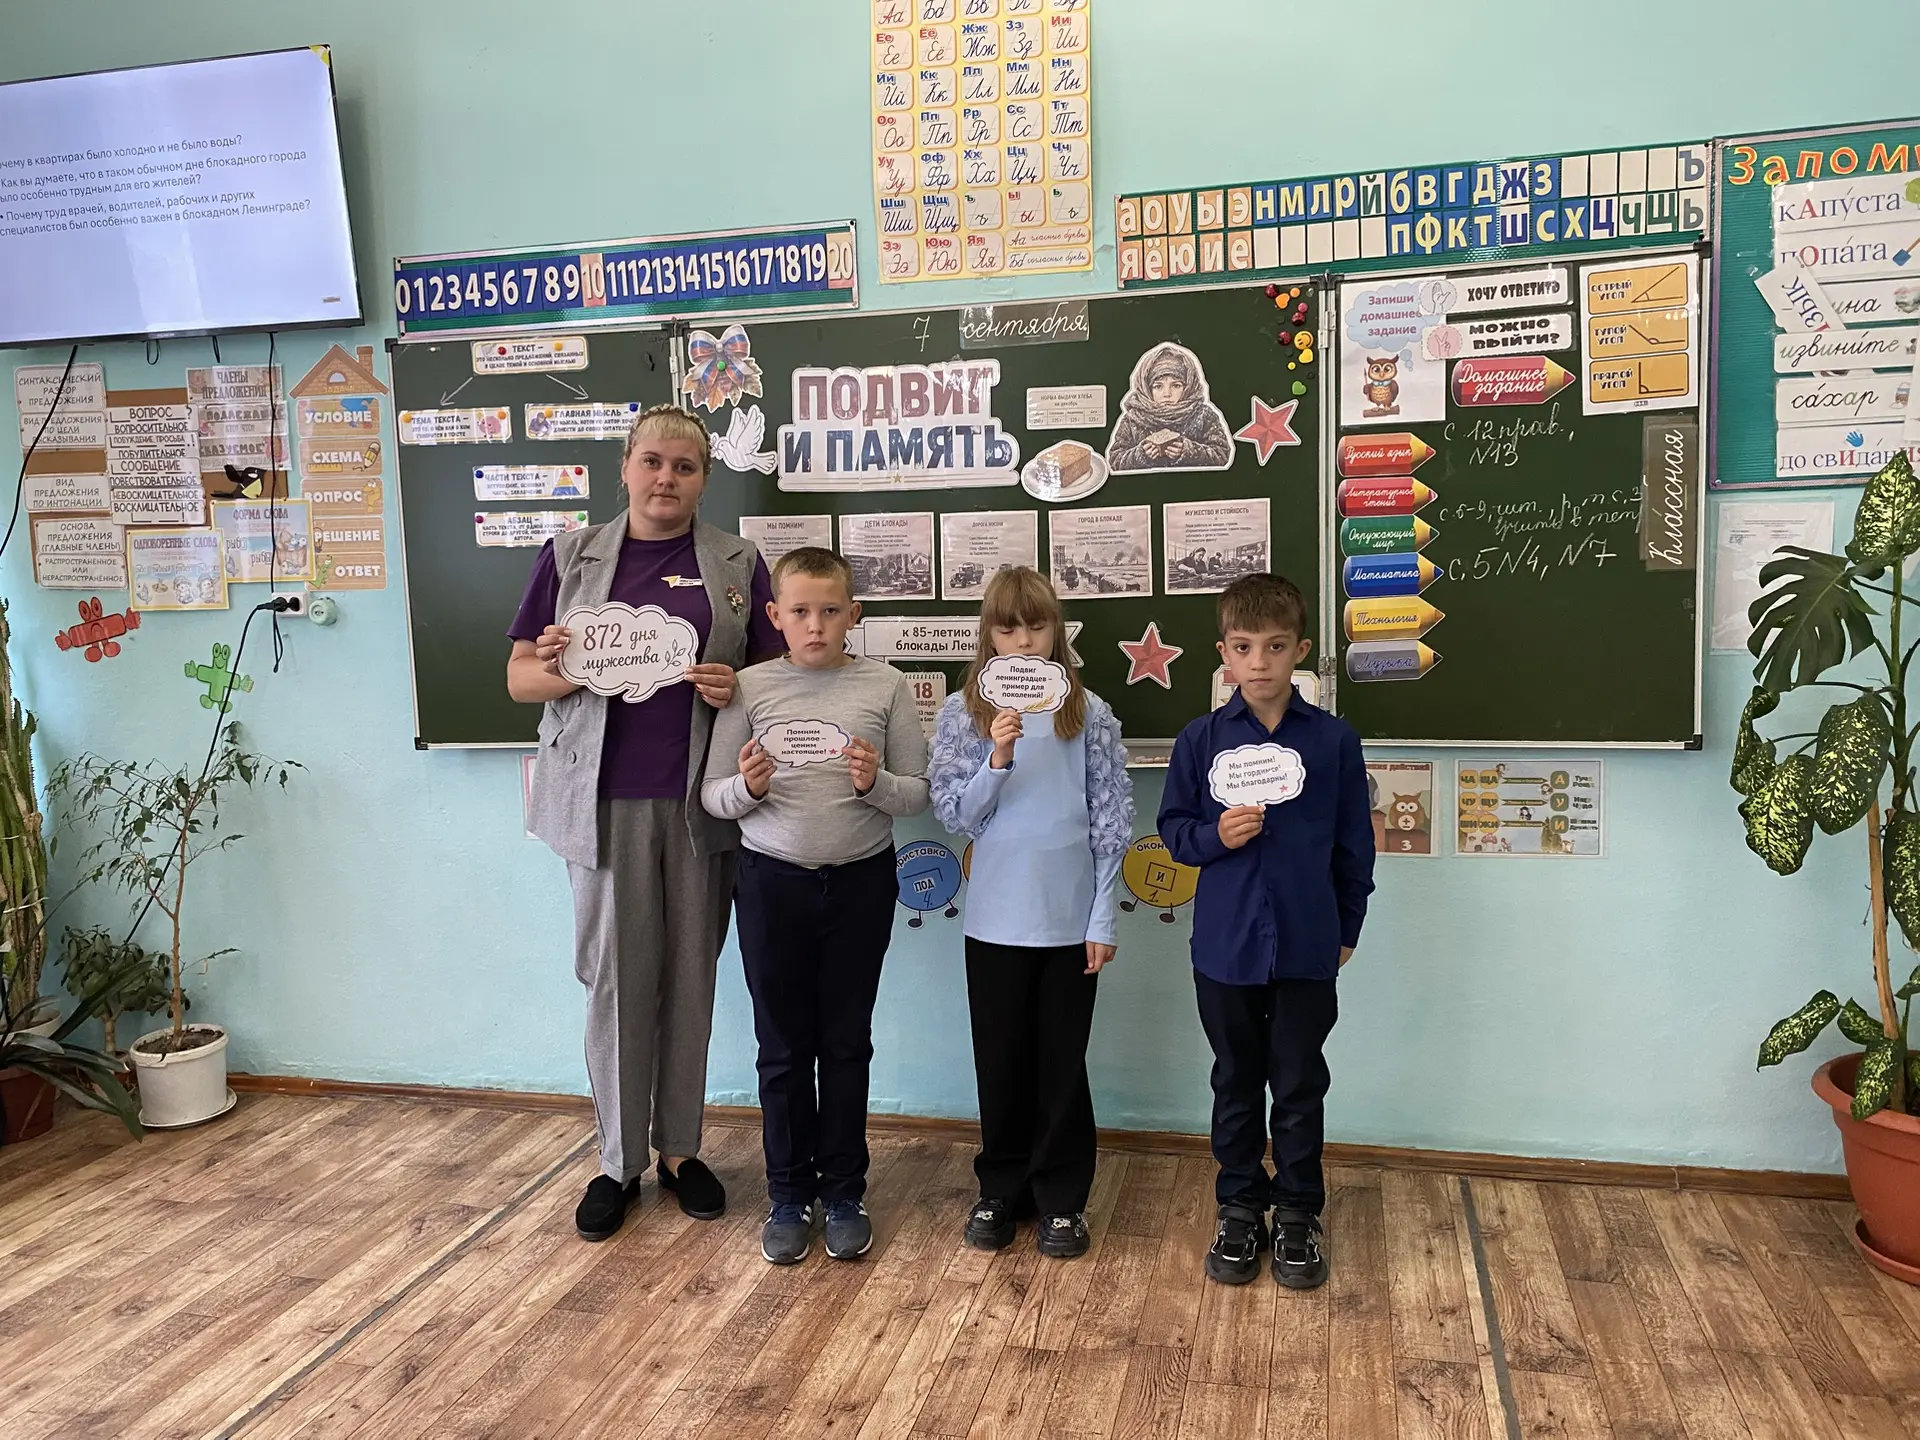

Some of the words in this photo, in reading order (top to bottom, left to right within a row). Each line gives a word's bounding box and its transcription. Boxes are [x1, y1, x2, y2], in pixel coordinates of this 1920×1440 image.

[35, 154, 85, 166] квартирах
[87, 149, 112, 160] было
[114, 145, 156, 158] холодно
[167, 143, 180, 152] не
[182, 139, 208, 150] было
[210, 134, 242, 148] воды?
[1, 178, 18, 188] Как
[35, 173, 78, 186] думаете,
[79, 171, 96, 180] что
[106, 167, 135, 178] таком
[137, 162, 183, 174] обычном
[185, 160, 204, 172] дне
[206, 154, 268, 168] блокадного
[270, 151, 306, 164] города
[1728, 142, 1920, 186] Запом
[21, 188, 68, 201] особенно
[70, 185, 112, 198] трудным
[114, 182, 132, 193] для
[134, 180, 150, 191] его
[152, 174, 202, 188] жителей?
[6, 209, 43, 222] Почему
[44, 207, 67, 220] труд
[69, 203, 107, 217] врачей,
[109, 199, 165, 213] водителей,
[167, 195, 210, 209] рабочих
[220, 190, 256, 204] других
[0, 221, 67, 237] специалистов
[70, 219, 88, 230] был
[90, 216, 138, 229] особенно
[141, 212, 172, 224] важен
[182, 205, 240, 220] блокадном
[242, 199, 311, 215] Ленинграде?
[1591, 280, 1632, 292] ОСТРЫЙ
[1468, 286, 1498, 302] ХОЧУ
[1599, 291, 1625, 300] УГОЛ
[1368, 295, 1414, 306] Запиши
[1368, 325, 1417, 337] задание
[1469, 318, 1551, 335] МОЖНО
[1594, 324, 1627, 336] ТУПОЙ
[913, 316, 931, 352] 7
[1472, 332, 1561, 350] ВЫЙТИ?
[1598, 336, 1624, 345] УГОЛ
[512, 344, 536, 353] ТЕКСТ
[216, 371, 248, 384] ЧЛЕНЫ
[1458, 362, 1548, 384] Домашнее
[1593, 368, 1632, 381] ПРЯМОЙ
[1472, 379, 1545, 402] задание
[1600, 380, 1626, 390] УГОЛ
[798, 367, 993, 426] ПОДВИГ
[130, 406, 173, 419] ВОПРОС
[304, 410, 372, 424] УСЛОВИЕ
[555, 409, 592, 418] ГЛАВНАЯ
[593, 408, 621, 417] МЫСЛЬ
[24, 417, 40, 426] ВИД
[412, 416, 432, 425] ТЕМА
[434, 415, 462, 424] ТЕКСТА
[58, 426, 80, 434] ЦЕЛИ
[114, 422, 188, 434] ВОПРОСИТЕЛЬНОЕ
[114, 436, 154, 444] ПОБУЖДЕНИЕ
[156, 434, 186, 443] ПРОСЬБА
[118, 448, 186, 459] ПОБУДИТЕЛЬНОЕ
[784, 430, 812, 474] И
[826, 425, 1012, 474] ПАМЯТЬ
[1344, 446, 1386, 465] Русский
[1387, 448, 1413, 462] язык
[312, 450, 363, 464] СХЕМА
[1780, 454, 1806, 470] до
[120, 460, 182, 472] СООБЩЕНИЕ
[56, 478, 75, 488] ВИД
[110, 476, 197, 486] ПОВЕСТВОВАТЕЛЬНОЕ
[485, 474, 510, 482] ЧАСТИ
[512, 472, 540, 480] ТЕКСТА
[34, 488, 100, 498] ПРЕДЛОЖЕНИЯ
[112, 490, 198, 500] НЕВОСКЛИЦАТЕЛЬНОЕ
[304, 490, 363, 504] ВОПРОС
[1344, 486, 1414, 500] Литературное
[33, 500, 44, 508] ПО
[46, 498, 103, 509] ИНТОНАЦИИ
[114, 502, 199, 514] ВОСКЛИЦАТЕЛЬНОЕ
[233, 508, 260, 520] ФОРМА
[264, 507, 288, 519] СЛОВА
[1078, 516, 1095, 524] ГОРОД
[1100, 514, 1123, 522] БЛОКАДЕ
[60, 522, 96, 531] ОСНОВА
[507, 516, 532, 525] АБЗАЦ
[766, 522, 778, 530] МЫ
[778, 522, 805, 530] ПОМНИМ!
[864, 520, 880, 528] ДЕТИ
[882, 519, 908, 528] БЛОКАДЫ
[48, 532, 113, 542] ПРЕДЛОЖЕНИЯ
[314, 529, 380, 542] РЕШЕНИЕ
[1348, 528, 1416, 545] Окружающий
[42, 543, 83, 552] (ГЛАВНЫЕ
[86, 542, 120, 551] ЧЛЕНЫ)
[134, 537, 192, 550] ОДНОКОРЕННЫЕ
[194, 536, 218, 548] СЛОВА
[1372, 540, 1396, 552] мир
[335, 565, 380, 578] ОТВЕТ
[1350, 568, 1421, 580] Математика
[1354, 612, 1419, 626] Технология
[583, 622, 622, 651] 872
[630, 628, 658, 650] дня
[912, 626, 971, 638] 85-летию
[896, 640, 948, 652] блокады
[582, 646, 660, 676] мужества
[1356, 652, 1413, 676] Музыка
[1010, 666, 1037, 675] Подвиг
[995, 674, 1047, 684] ленинградцев
[914, 682, 932, 698] 18
[1002, 683, 1030, 692] пример
[1031, 683, 1044, 692] для
[1002, 690, 1044, 700] поколений!
[1229, 762, 1242, 770] Мы
[1244, 756, 1276, 769] помним!
[1228, 772, 1242, 780] Мы
[1244, 764, 1282, 779] гордимся!
[1226, 782, 1240, 790] Мы
[1241, 773, 1288, 788] благодарны!
[1460, 775, 1476, 784] ЧА
[1480, 775, 1498, 784] ЩА
[1462, 798, 1476, 806] ЧУ
[1480, 798, 1498, 807] ЩУ
[1460, 820, 1478, 829] ШИ
[1479, 820, 1498, 829] ЖИ
[1402, 840, 1412, 851] 3
[914, 878, 934, 892] ПОД
